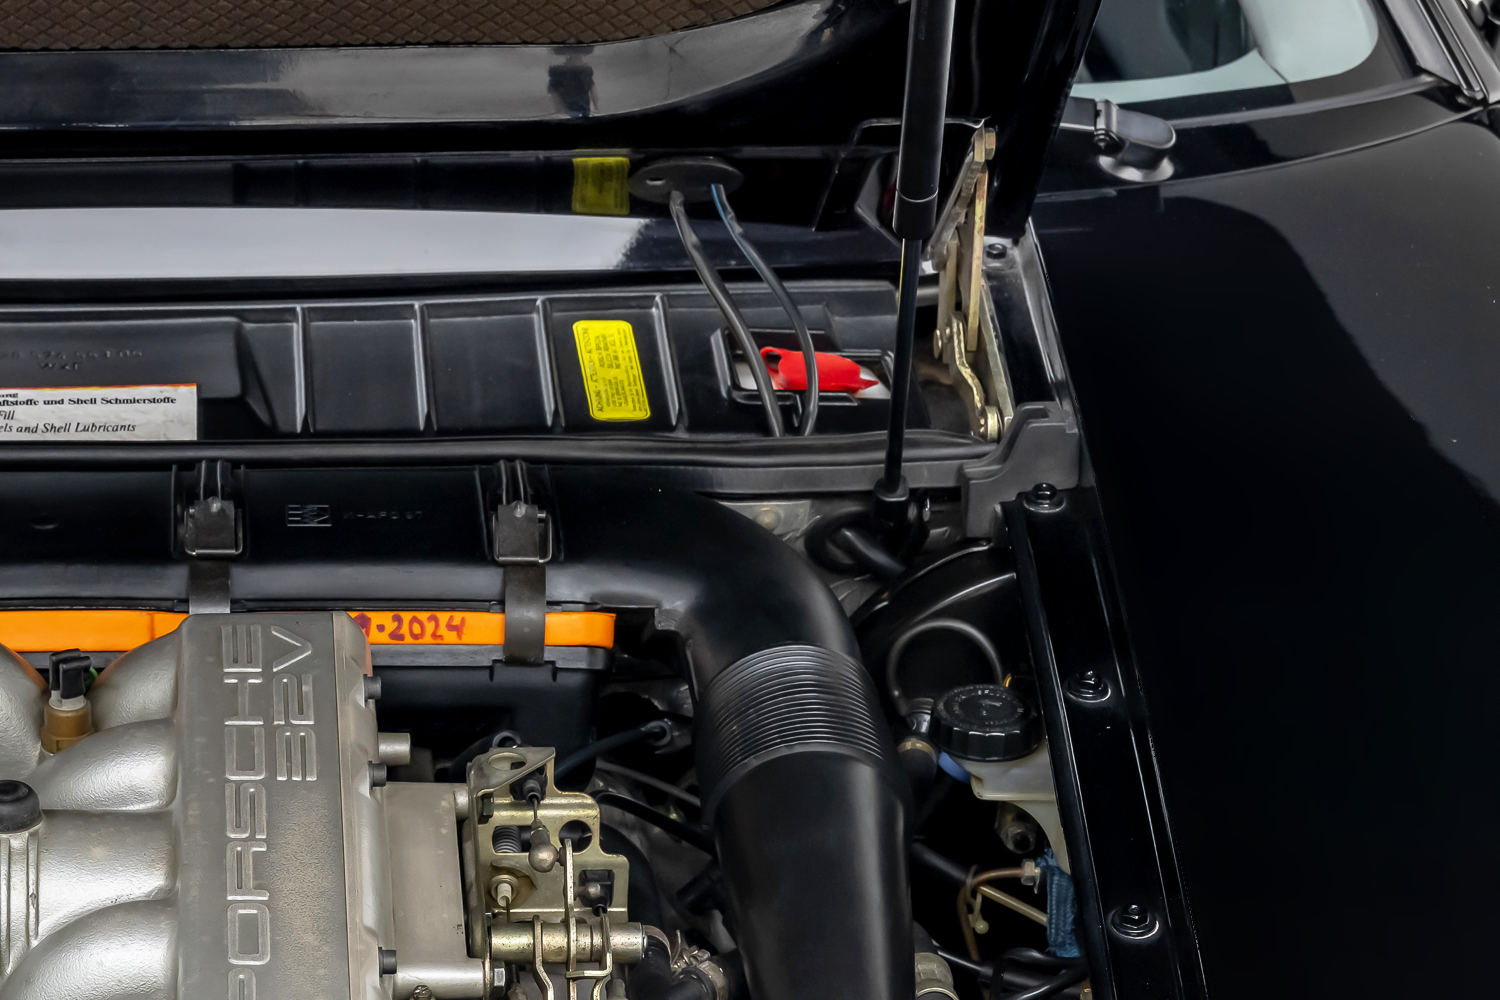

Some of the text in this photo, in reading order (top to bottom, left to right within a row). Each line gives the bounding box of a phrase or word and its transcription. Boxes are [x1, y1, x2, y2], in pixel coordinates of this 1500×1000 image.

[43, 398, 65, 406] und
[68, 397, 97, 405] Shell
[100, 396, 177, 405] Schmierstoffe
[16, 423, 39, 434] and
[41, 422, 71, 434] Shell
[74, 422, 137, 433] Lubricants
[270, 624, 319, 782] 32V
